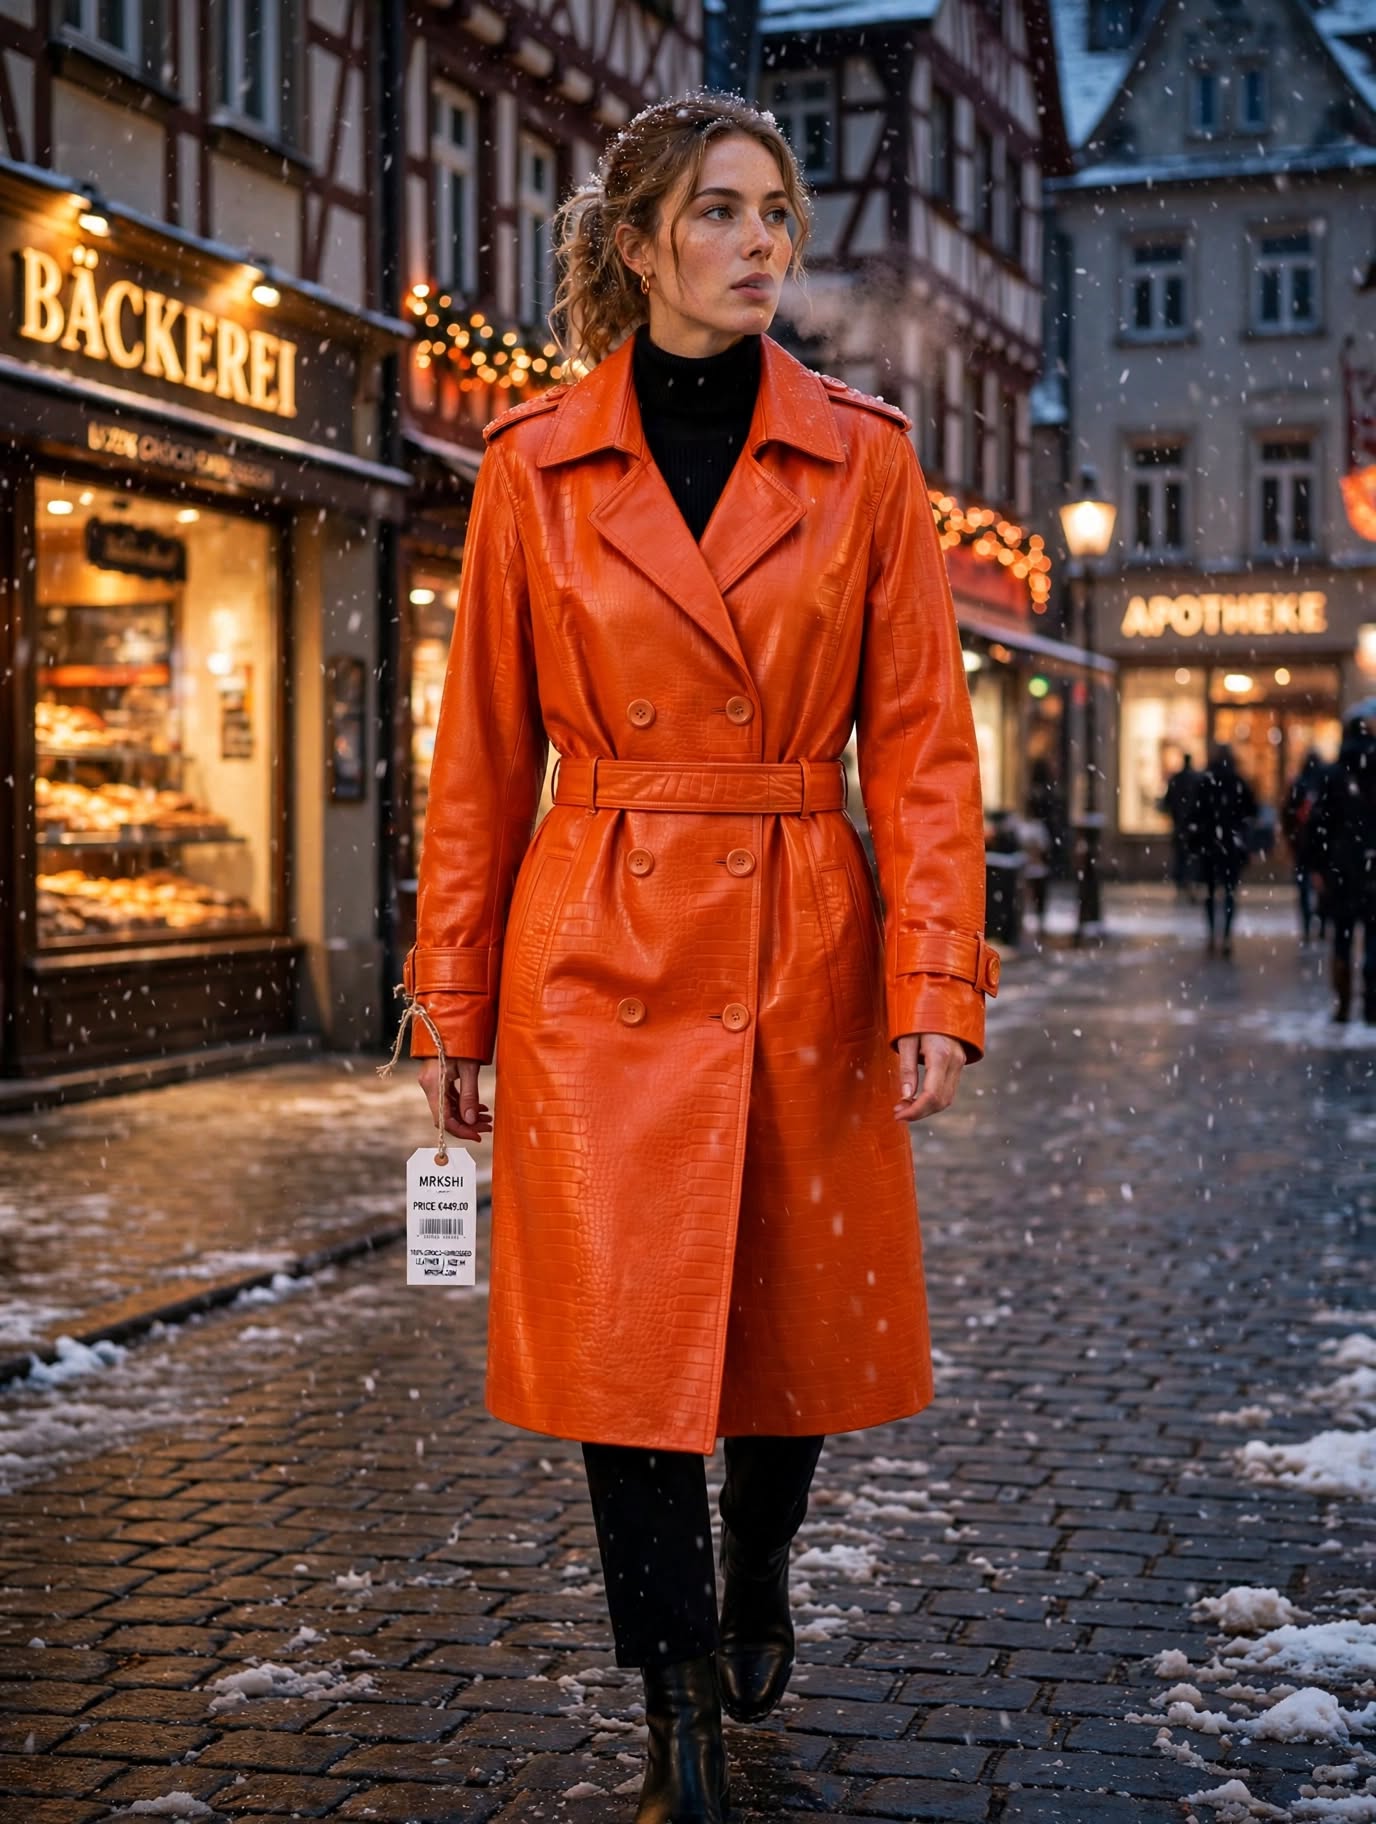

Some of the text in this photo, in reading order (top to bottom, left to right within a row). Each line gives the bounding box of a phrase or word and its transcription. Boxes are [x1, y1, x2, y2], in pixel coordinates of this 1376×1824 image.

[20, 244, 298, 418] BÄCKEREI
[1120, 590, 1328, 638] APOTHEKE
[419, 1175, 464, 1188] MRKSHI
[413, 1201, 436, 1211] PRICE
